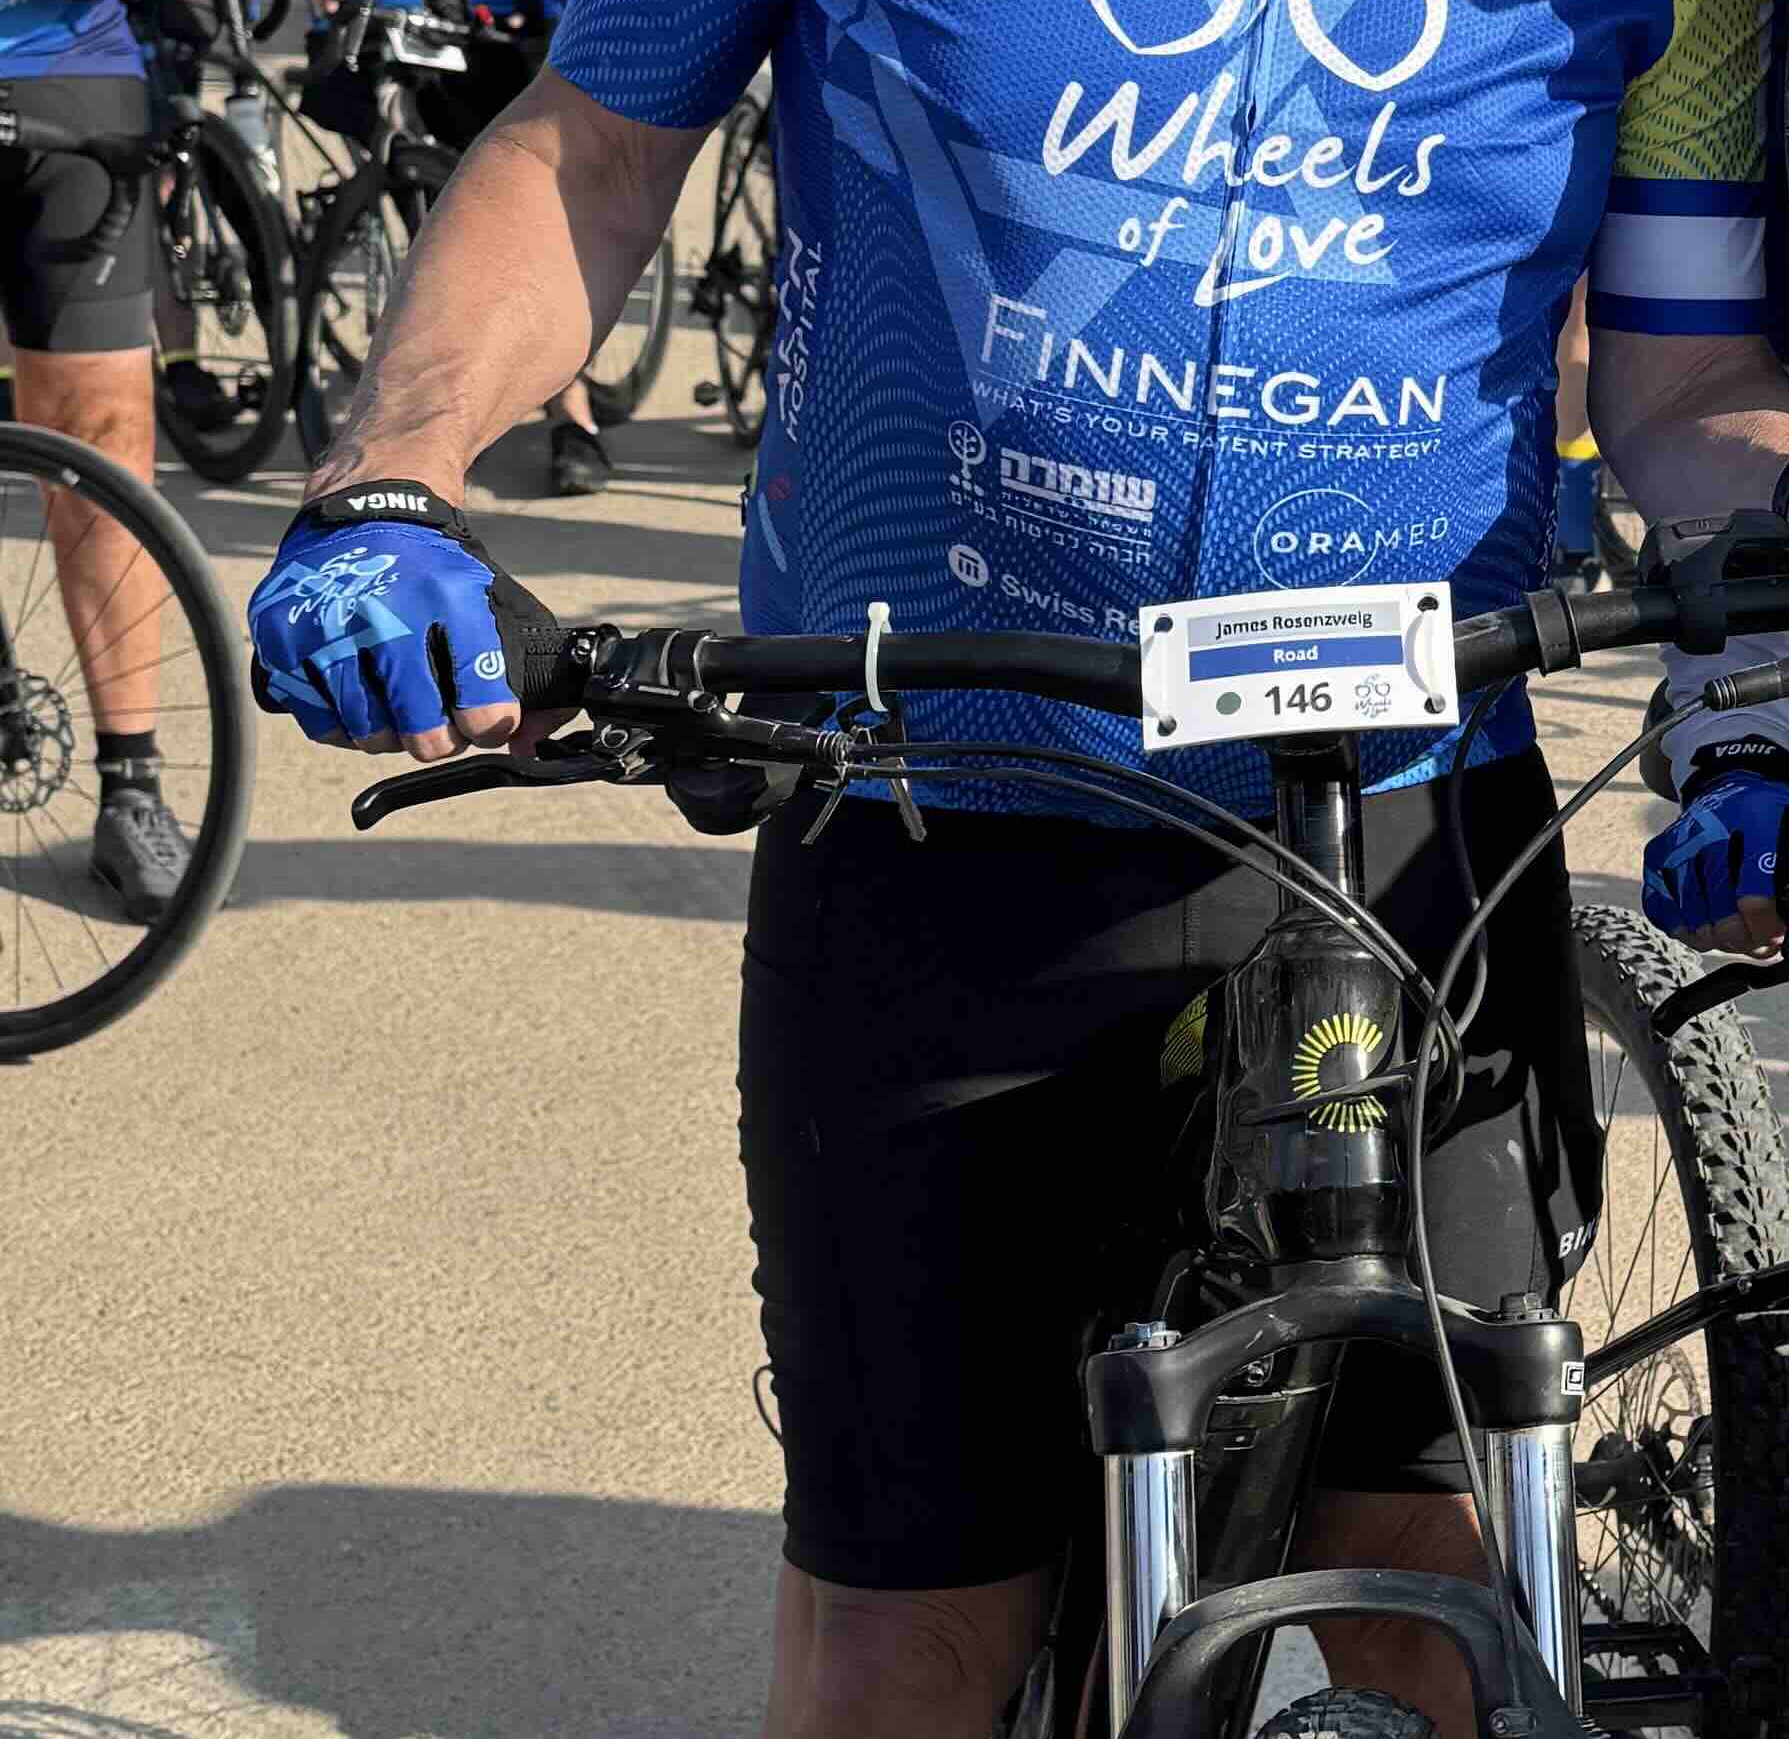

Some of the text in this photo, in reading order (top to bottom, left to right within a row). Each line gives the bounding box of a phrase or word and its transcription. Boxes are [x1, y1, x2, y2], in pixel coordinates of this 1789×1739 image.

[1042, 68, 1447, 197] Wheels
[1117, 196, 1400, 308] of Love
[786, 240, 822, 444] HOSPITAL
[980, 293, 1447, 428] FINNEGAN
[971, 380, 1442, 460] WHAT'S YOUR PATENT STRATEGY?
[347, 492, 428, 513] JINGA
[1000, 447, 1157, 510] שומרה
[1270, 516, 1449, 555] ORAMED
[1001, 573, 1095, 622] Swiss
[1215, 610, 1373, 640] James Rosenzweig
[1273, 645, 1319, 664] Road
[1264, 682, 1333, 716] 146
[1715, 743, 1777, 758] JINGA
